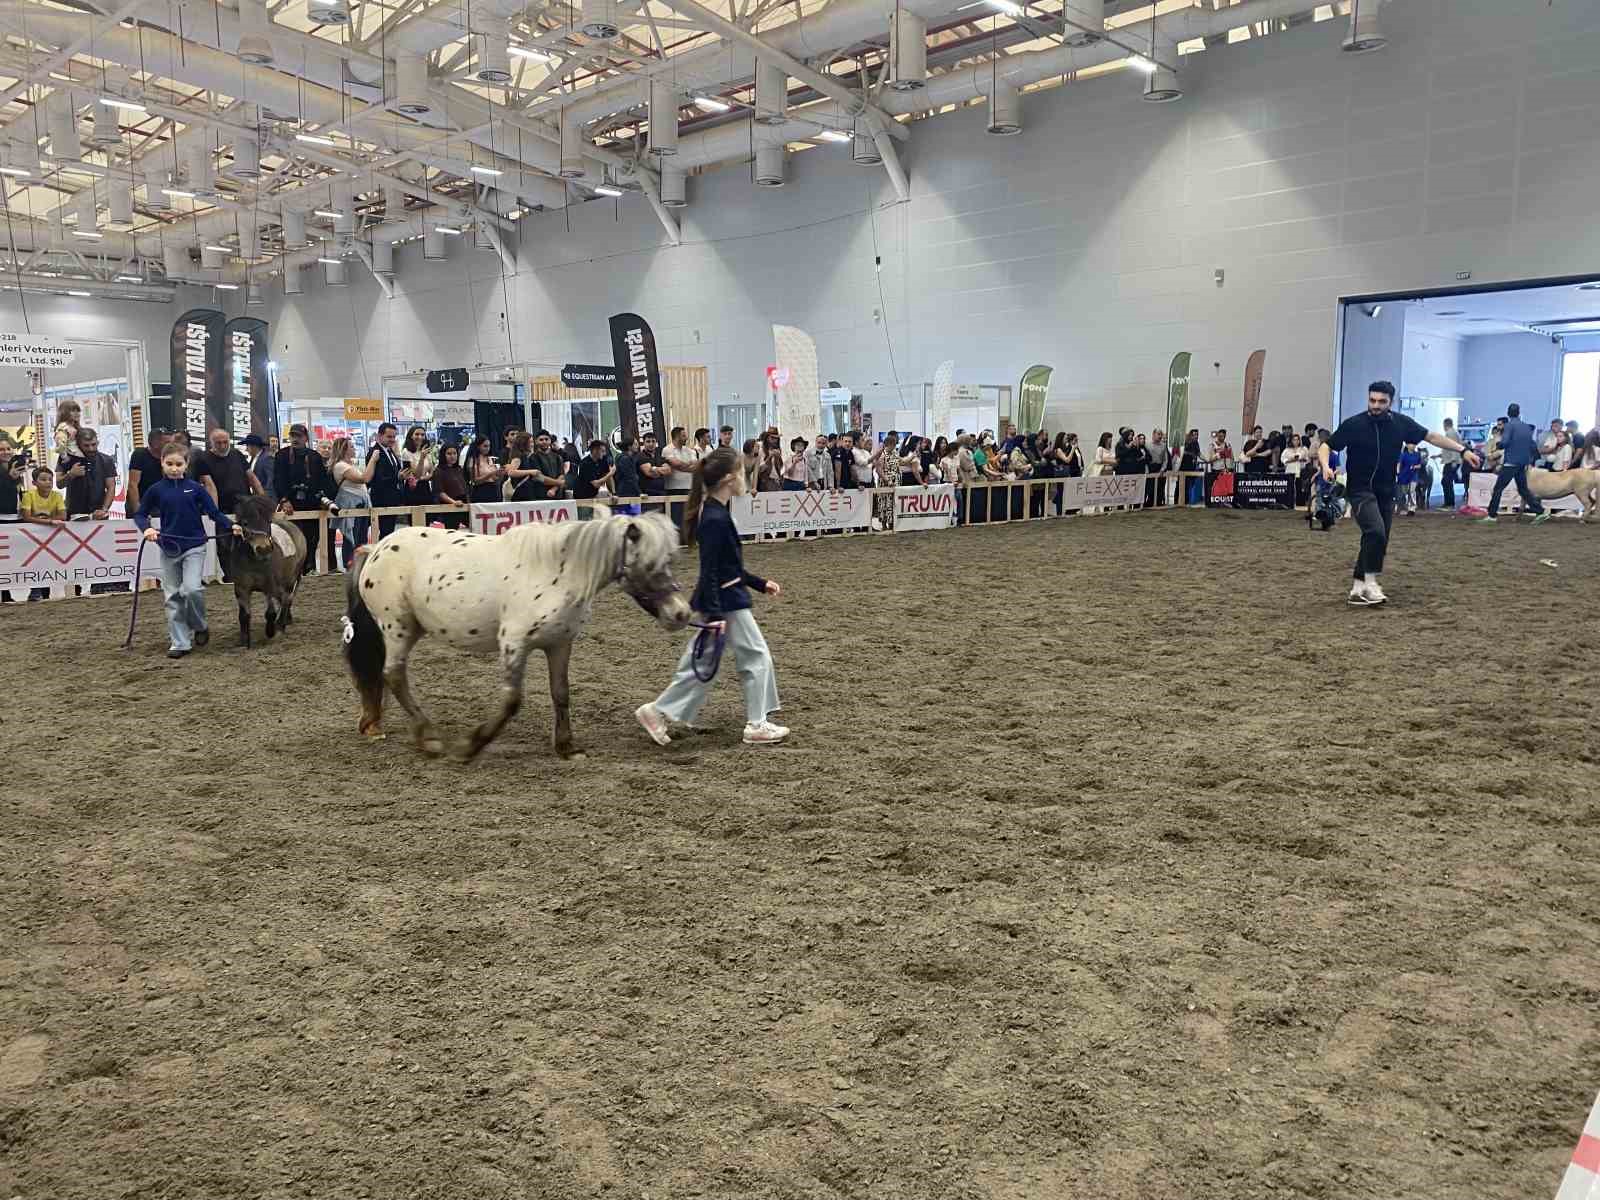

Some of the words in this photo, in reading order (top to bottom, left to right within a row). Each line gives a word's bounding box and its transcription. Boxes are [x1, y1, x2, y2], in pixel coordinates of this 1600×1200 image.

[24, 345, 73, 355] Veteriner
[186, 373, 206, 398] AT
[1076, 478, 1137, 496] FLEXXER
[751, 493, 852, 518] FLEXXER
[898, 494, 951, 513] TRUVA
[763, 519, 811, 530] EQUESTRIAN
[812, 518, 837, 527] FLOOR
[74, 564, 136, 580] FLOOR
